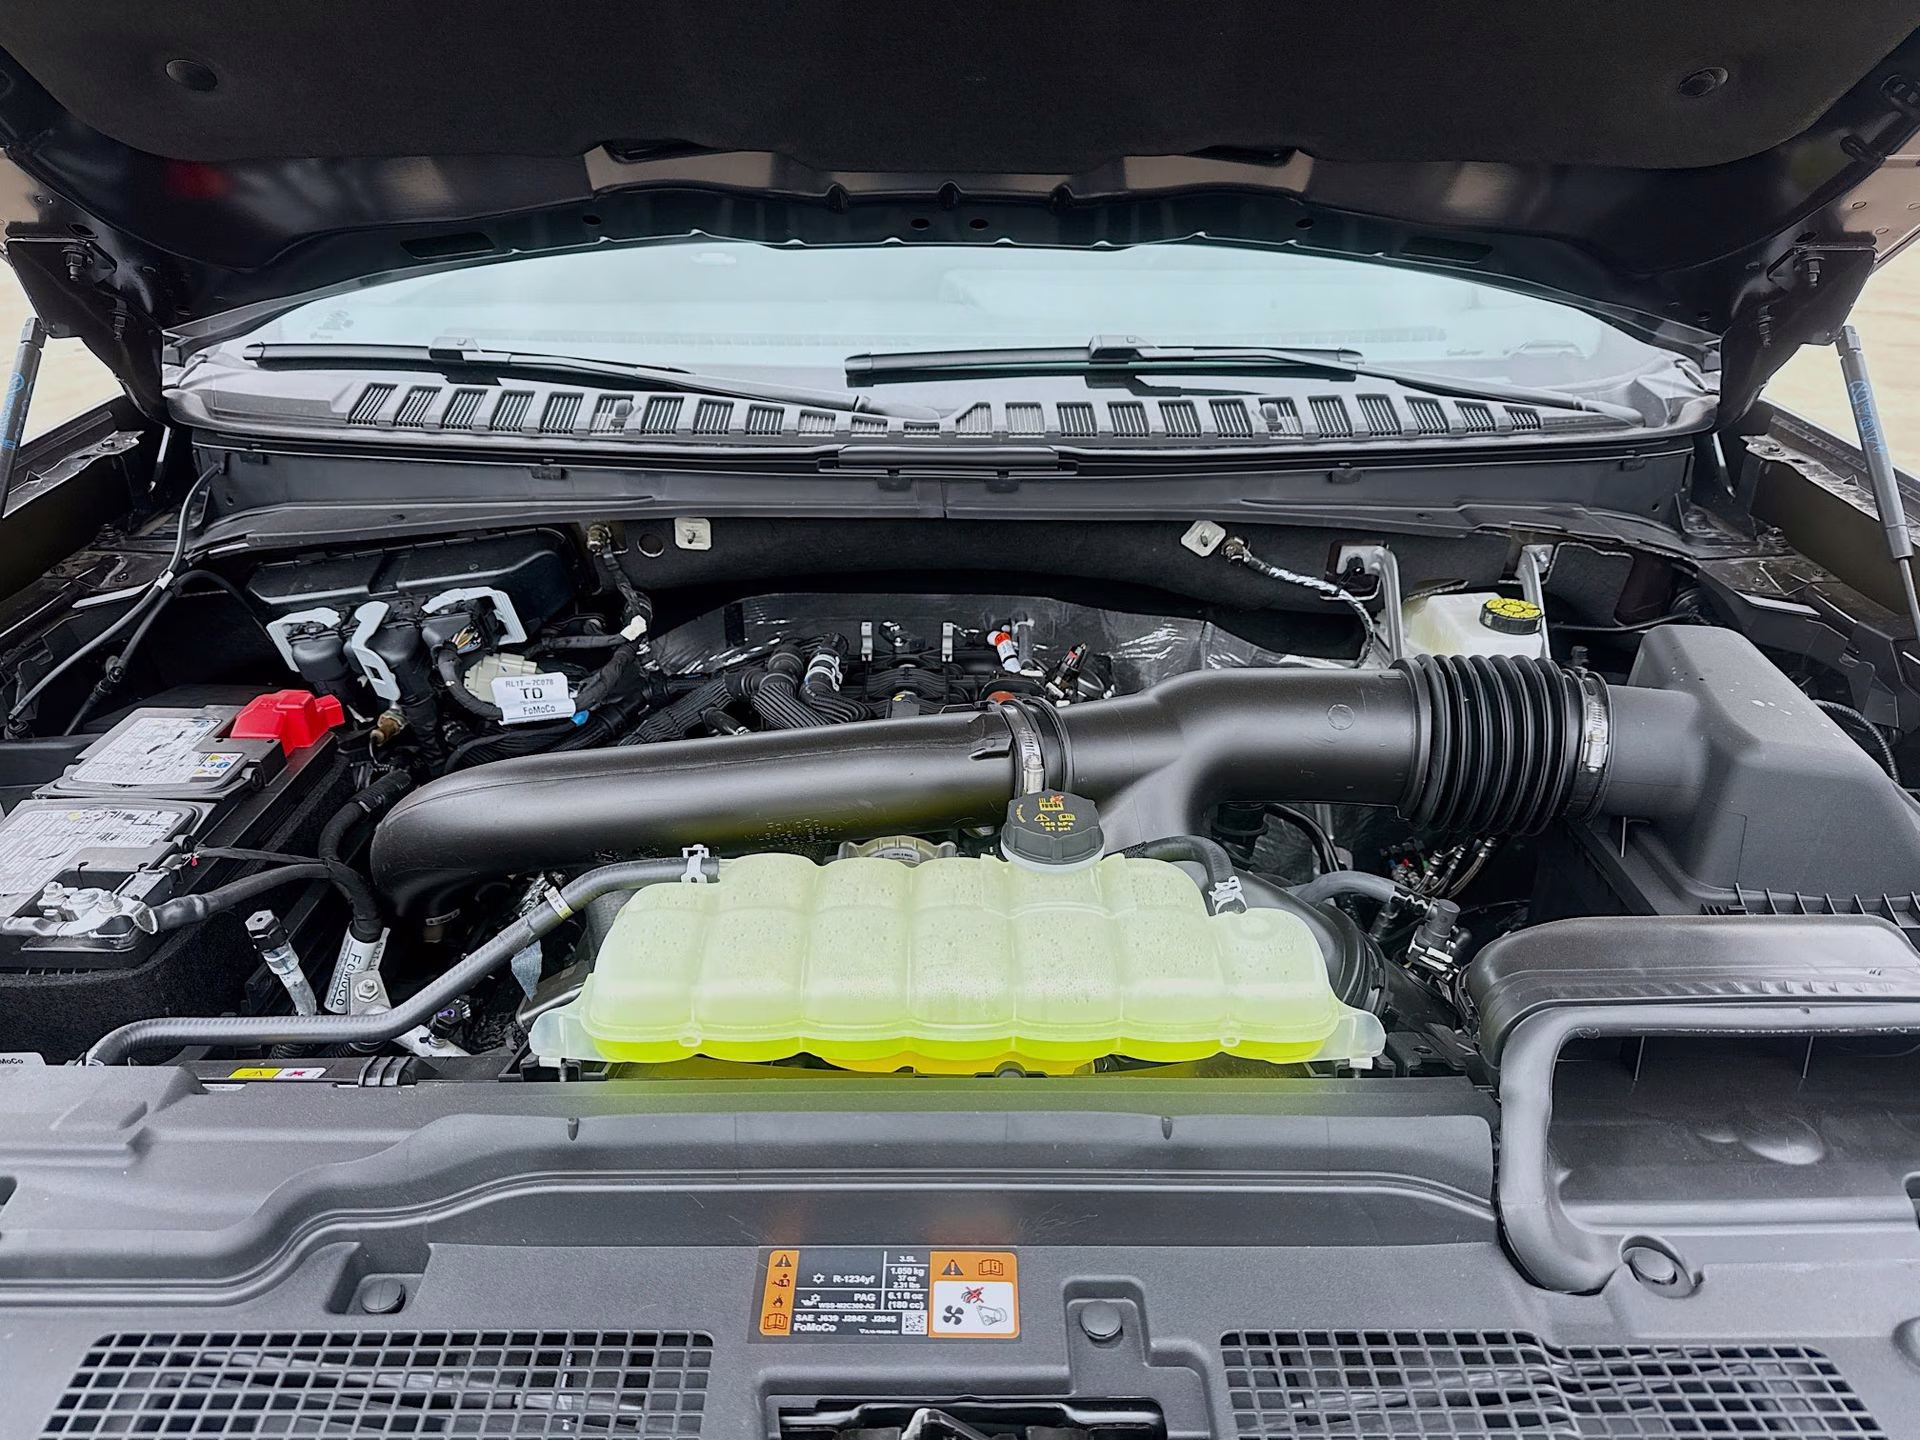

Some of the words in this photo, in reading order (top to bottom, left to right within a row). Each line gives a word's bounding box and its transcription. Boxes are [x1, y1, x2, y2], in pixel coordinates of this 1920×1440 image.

[522, 704, 556, 716] FoMoCo
[913, 1267, 925, 1277] kg
[832, 1275, 875, 1285] R-1234yf
[853, 1293, 876, 1302] PAG
[887, 1292, 901, 1300] 6.1
[909, 1301, 925, 1310] cc)
[795, 1314, 815, 1322] SAE
[793, 1322, 837, 1332] FoMoCo
